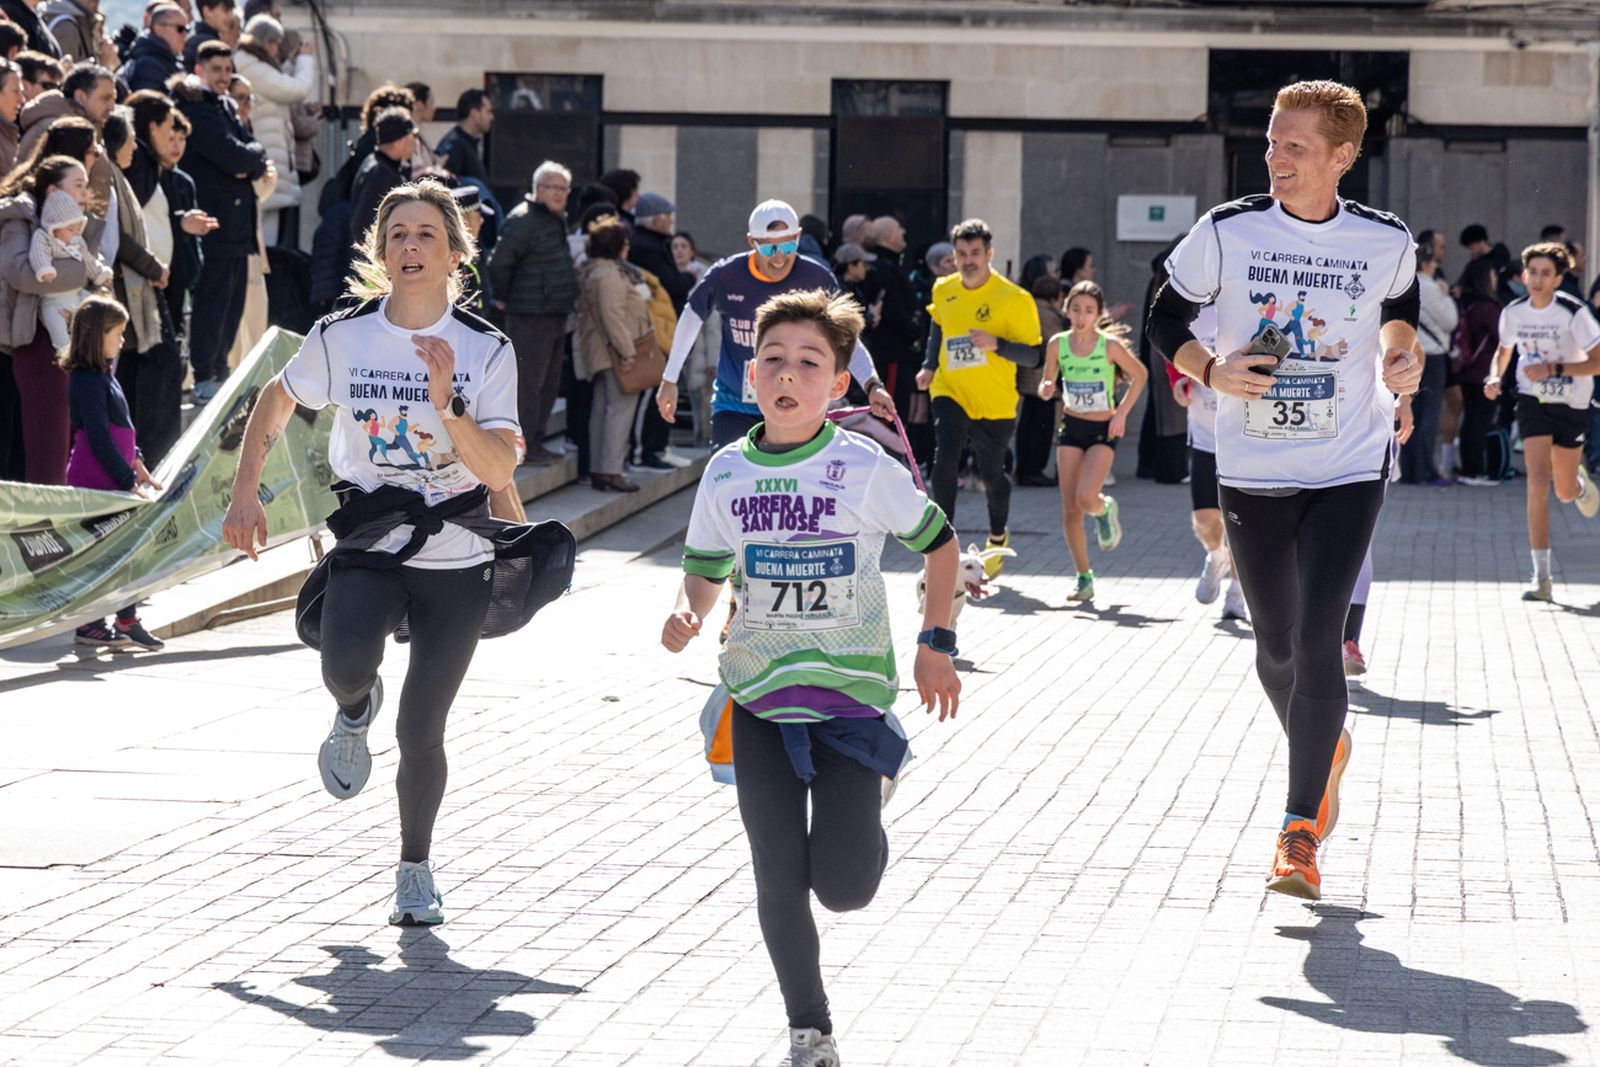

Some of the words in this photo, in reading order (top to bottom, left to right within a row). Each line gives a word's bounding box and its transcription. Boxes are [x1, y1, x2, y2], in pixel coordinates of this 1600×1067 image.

[1251, 250, 1260, 260] VI
[1263, 252, 1312, 266] CARRERA
[1315, 257, 1368, 271] CAMINATA
[1248, 266, 1288, 285] BUENA
[1293, 270, 1344, 290] MUERTE
[729, 317, 750, 330] CLUB
[349, 367, 358, 377] VI
[360, 368, 411, 381] CARRERA
[415, 371, 471, 382] CAATA
[350, 383, 387, 399] BUENA
[392, 386, 430, 402] MUER
[1280, 387, 1311, 398] MUERTE
[1541, 383, 1564, 396] 332
[1073, 393, 1094, 406] 715
[1272, 400, 1306, 426] 35
[755, 478, 798, 493] XXXVI
[731, 494, 807, 517] CARRERA
[812, 496, 836, 517] DE
[742, 512, 773, 533] SAN
[777, 511, 819, 533] JOSE
[755, 549, 763, 558] VI
[764, 549, 800, 559] CARRERA
[801, 547, 844, 559] CAMINATA
[755, 561, 784, 576] BUENA
[786, 562, 826, 577] MUERTE
[770, 580, 829, 612] 712
